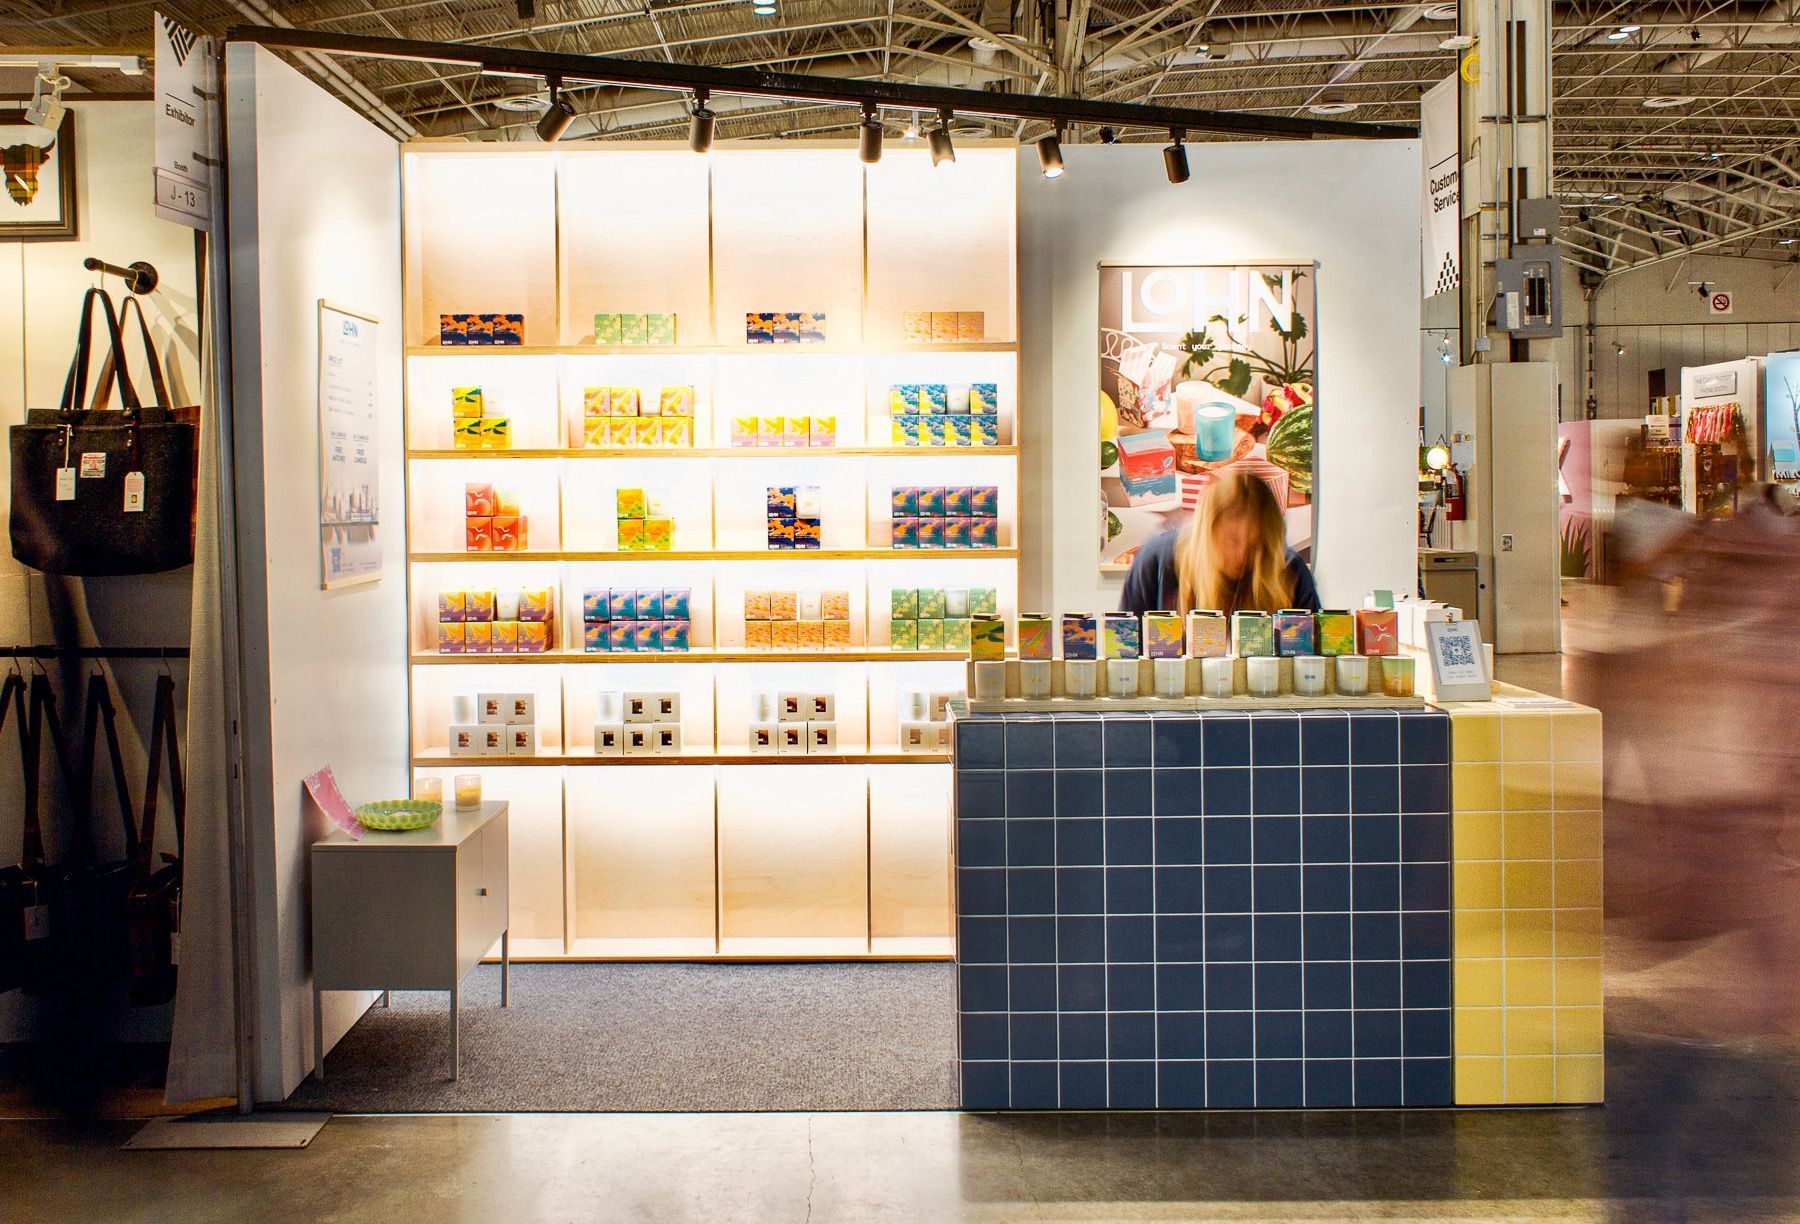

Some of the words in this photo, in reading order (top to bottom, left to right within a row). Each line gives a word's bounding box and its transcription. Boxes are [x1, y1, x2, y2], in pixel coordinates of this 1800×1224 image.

[166, 103, 195, 127] Exhibitor
[174, 160, 188, 172] Booth
[1430, 171, 1458, 195] Custom
[1123, 271, 1293, 332] LOHN
[1191, 343, 1213, 352] your
